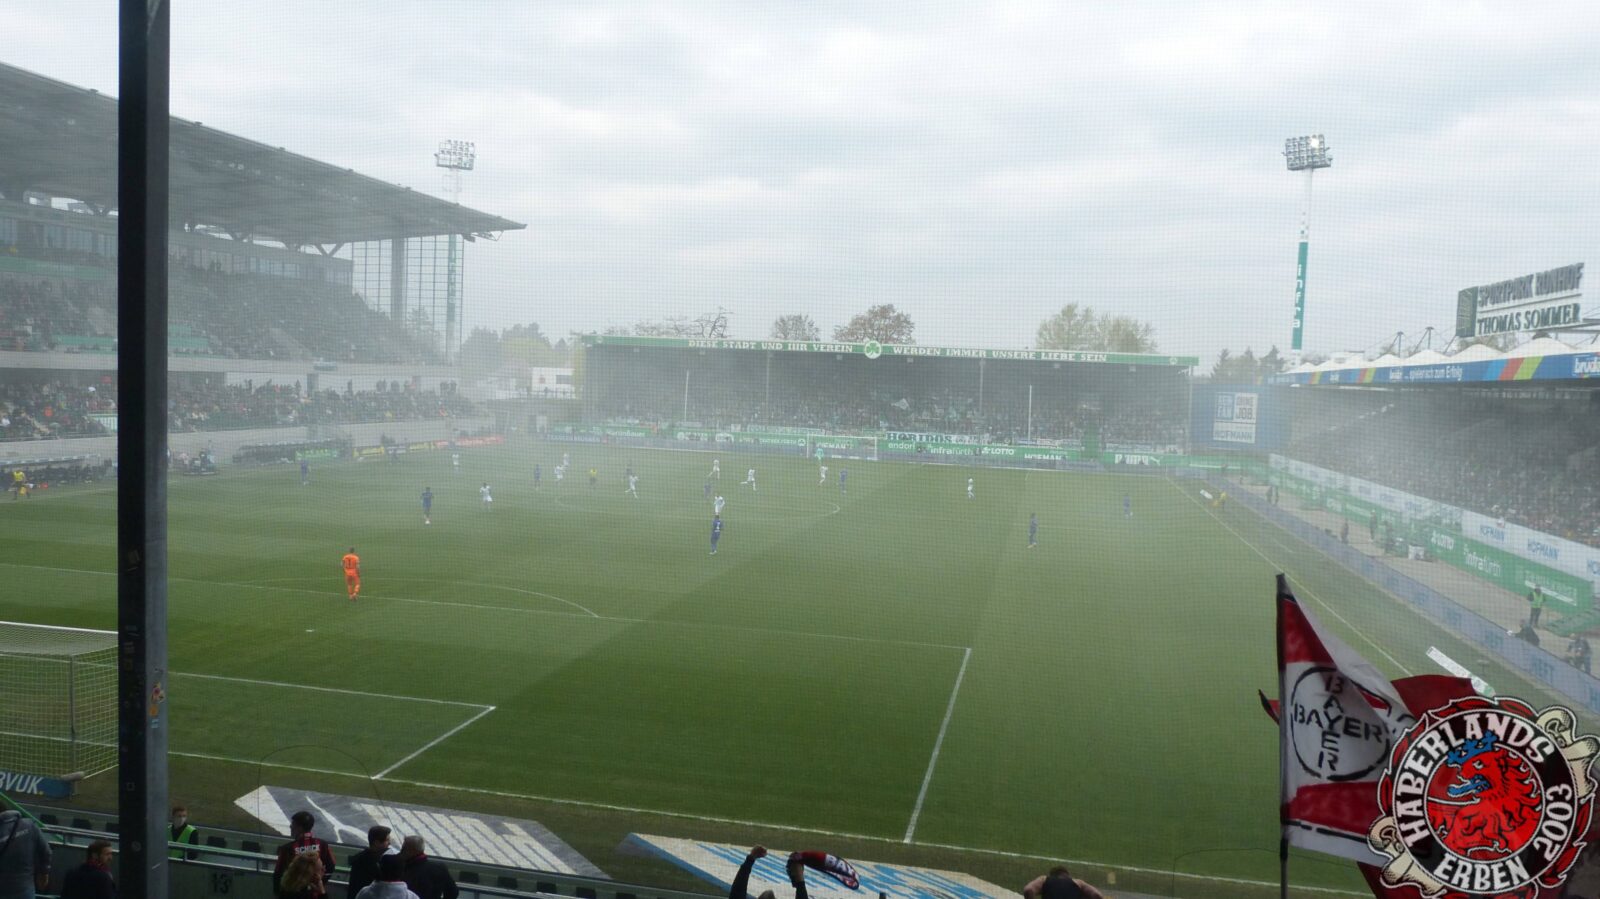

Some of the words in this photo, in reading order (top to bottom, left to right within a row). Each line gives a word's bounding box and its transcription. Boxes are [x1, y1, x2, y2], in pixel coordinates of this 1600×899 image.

[1479, 274, 1534, 308] SPORTPARK
[1477, 312, 1521, 335] THOMAS
[1524, 303, 1581, 330] SOMMER
[688, 340, 718, 348] DIESE
[722, 341, 755, 349] STADT
[788, 343, 807, 351] IHR
[813, 344, 853, 353] VEREIN
[893, 346, 940, 356] WERDEN
[946, 349, 987, 358] IMMER
[992, 351, 1036, 360] UNSERE
[1041, 353, 1075, 361] LIEBE
[1080, 354, 1107, 362] SEIN
[1528, 538, 1558, 561] HOFMANN
[1294, 702, 1382, 743] BAYER
